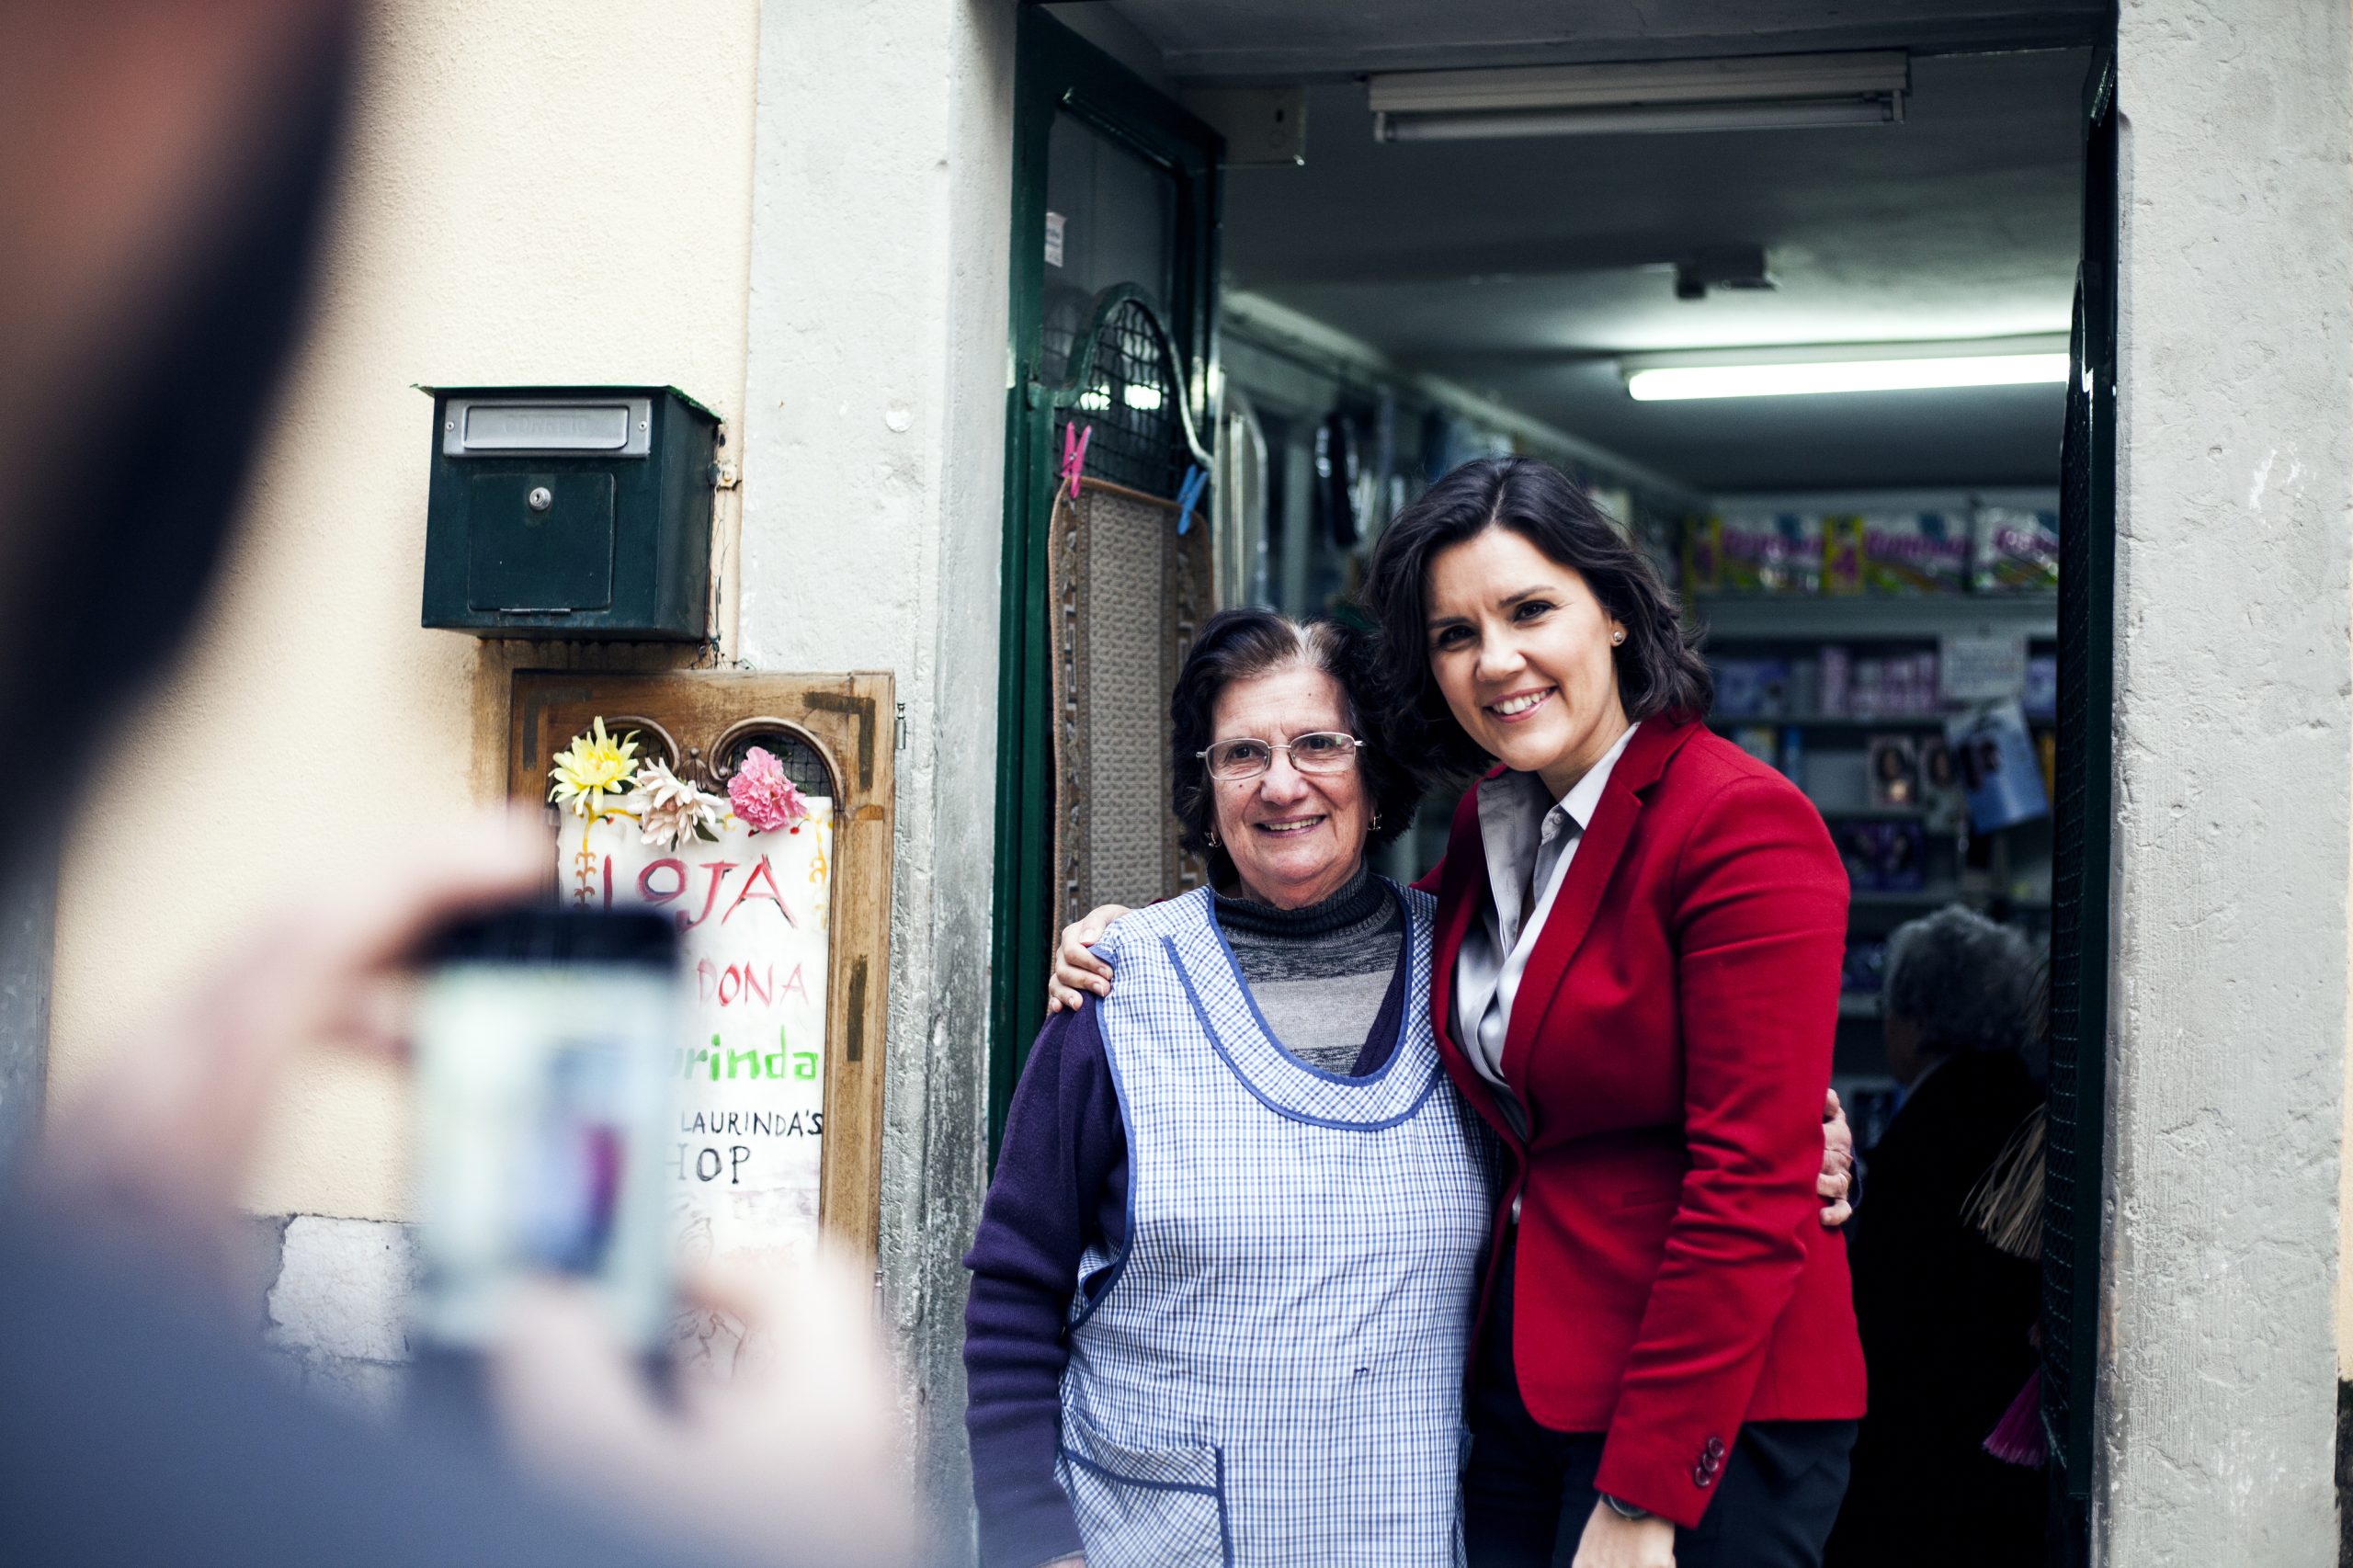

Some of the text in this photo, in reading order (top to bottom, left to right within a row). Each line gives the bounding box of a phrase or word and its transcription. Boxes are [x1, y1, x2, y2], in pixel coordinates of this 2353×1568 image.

[696, 957, 810, 1009] DONA
[665, 1023, 820, 1082] rinda
[680, 1108, 824, 1139] LAURINDA'S
[665, 1142, 752, 1186] HOP
